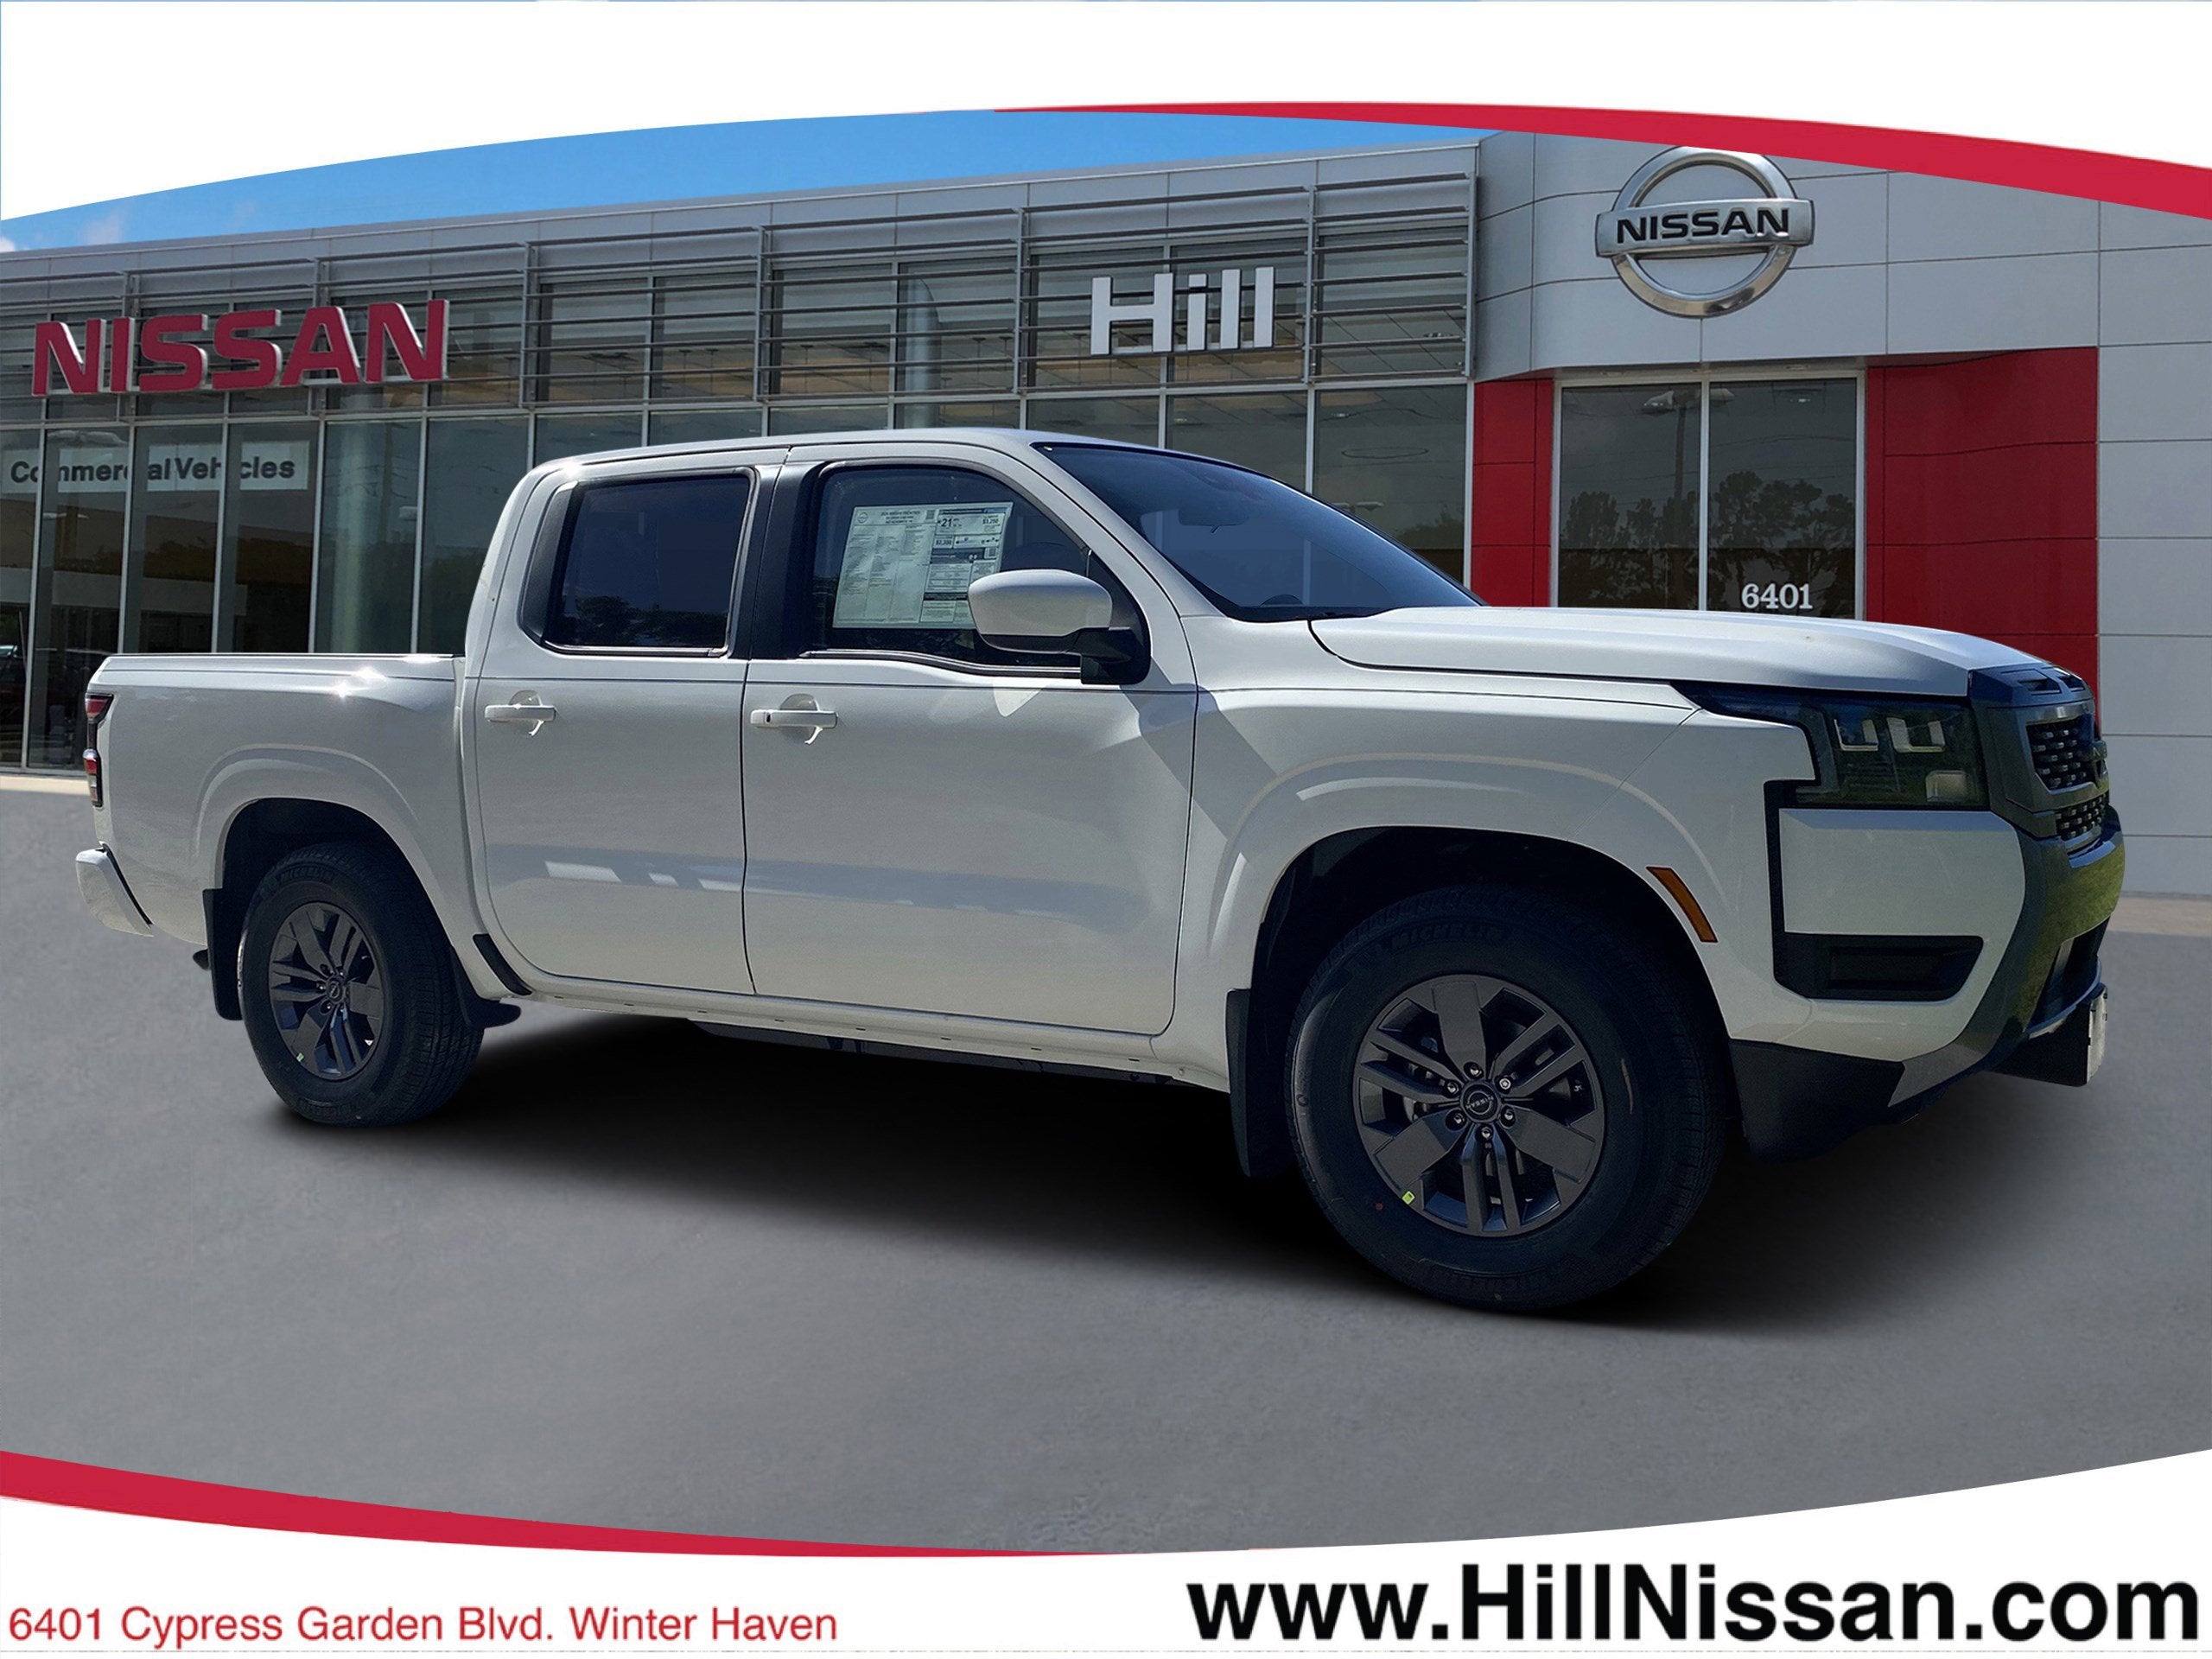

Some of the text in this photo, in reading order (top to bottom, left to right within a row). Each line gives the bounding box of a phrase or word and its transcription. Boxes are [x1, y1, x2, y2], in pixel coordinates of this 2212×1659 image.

[1617, 207, 1789, 245] NISSAN
[1090, 266, 1274, 355] Hill
[31, 299, 449, 397] NISSAN
[10, 456, 295, 483] Comeral Vehcles
[1741, 583, 1813, 609] 6401
[1391, 923, 1505, 949] MICHELIN
